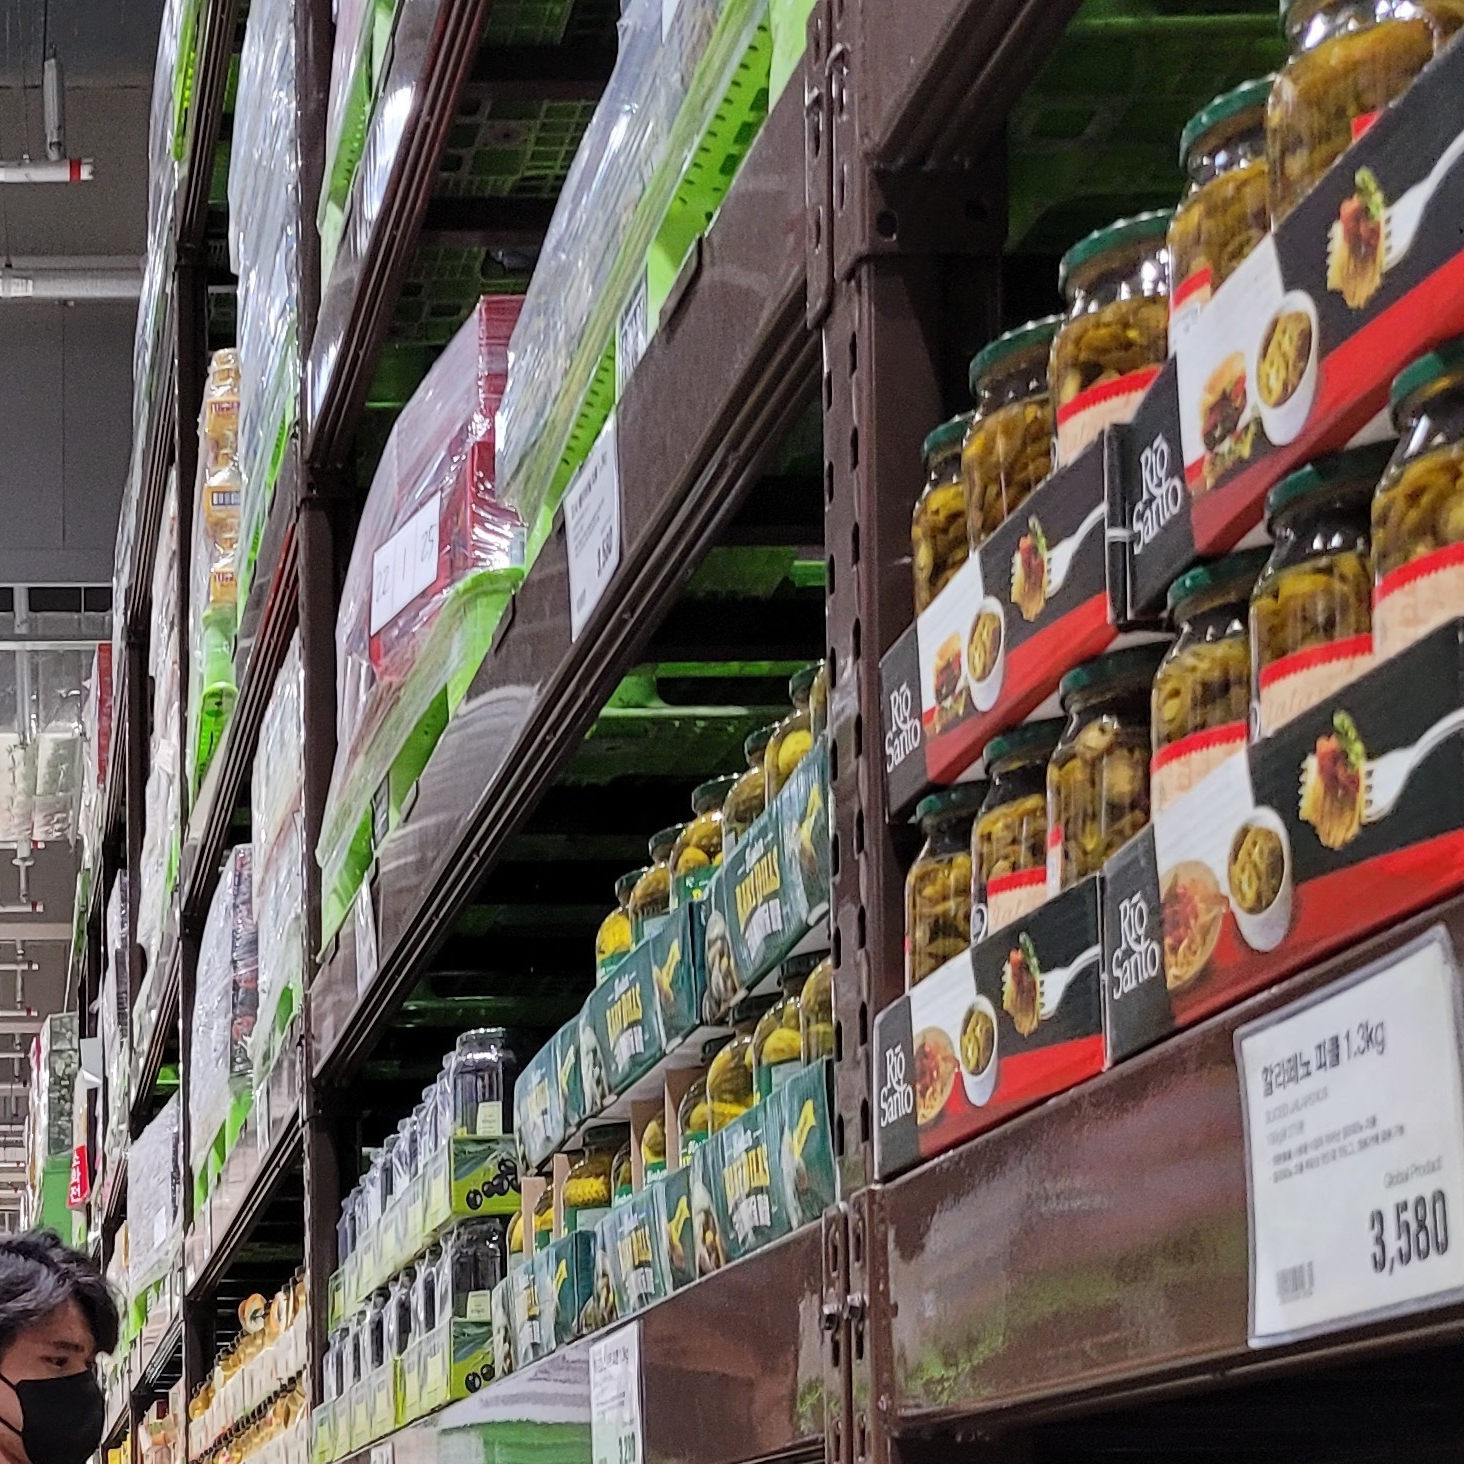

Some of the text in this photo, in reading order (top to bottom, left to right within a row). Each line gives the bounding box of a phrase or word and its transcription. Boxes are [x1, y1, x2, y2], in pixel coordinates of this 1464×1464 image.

[1133, 476, 1183, 554] Santo
[886, 718, 920, 774] Santo
[1112, 941, 1161, 1001] Santo
[1314, 1035, 1340, 1073] 피클
[1343, 1019, 1386, 1061] 1.3kg
[880, 1083, 914, 1128] Santo
[1368, 1186, 1450, 1275] 3,580
